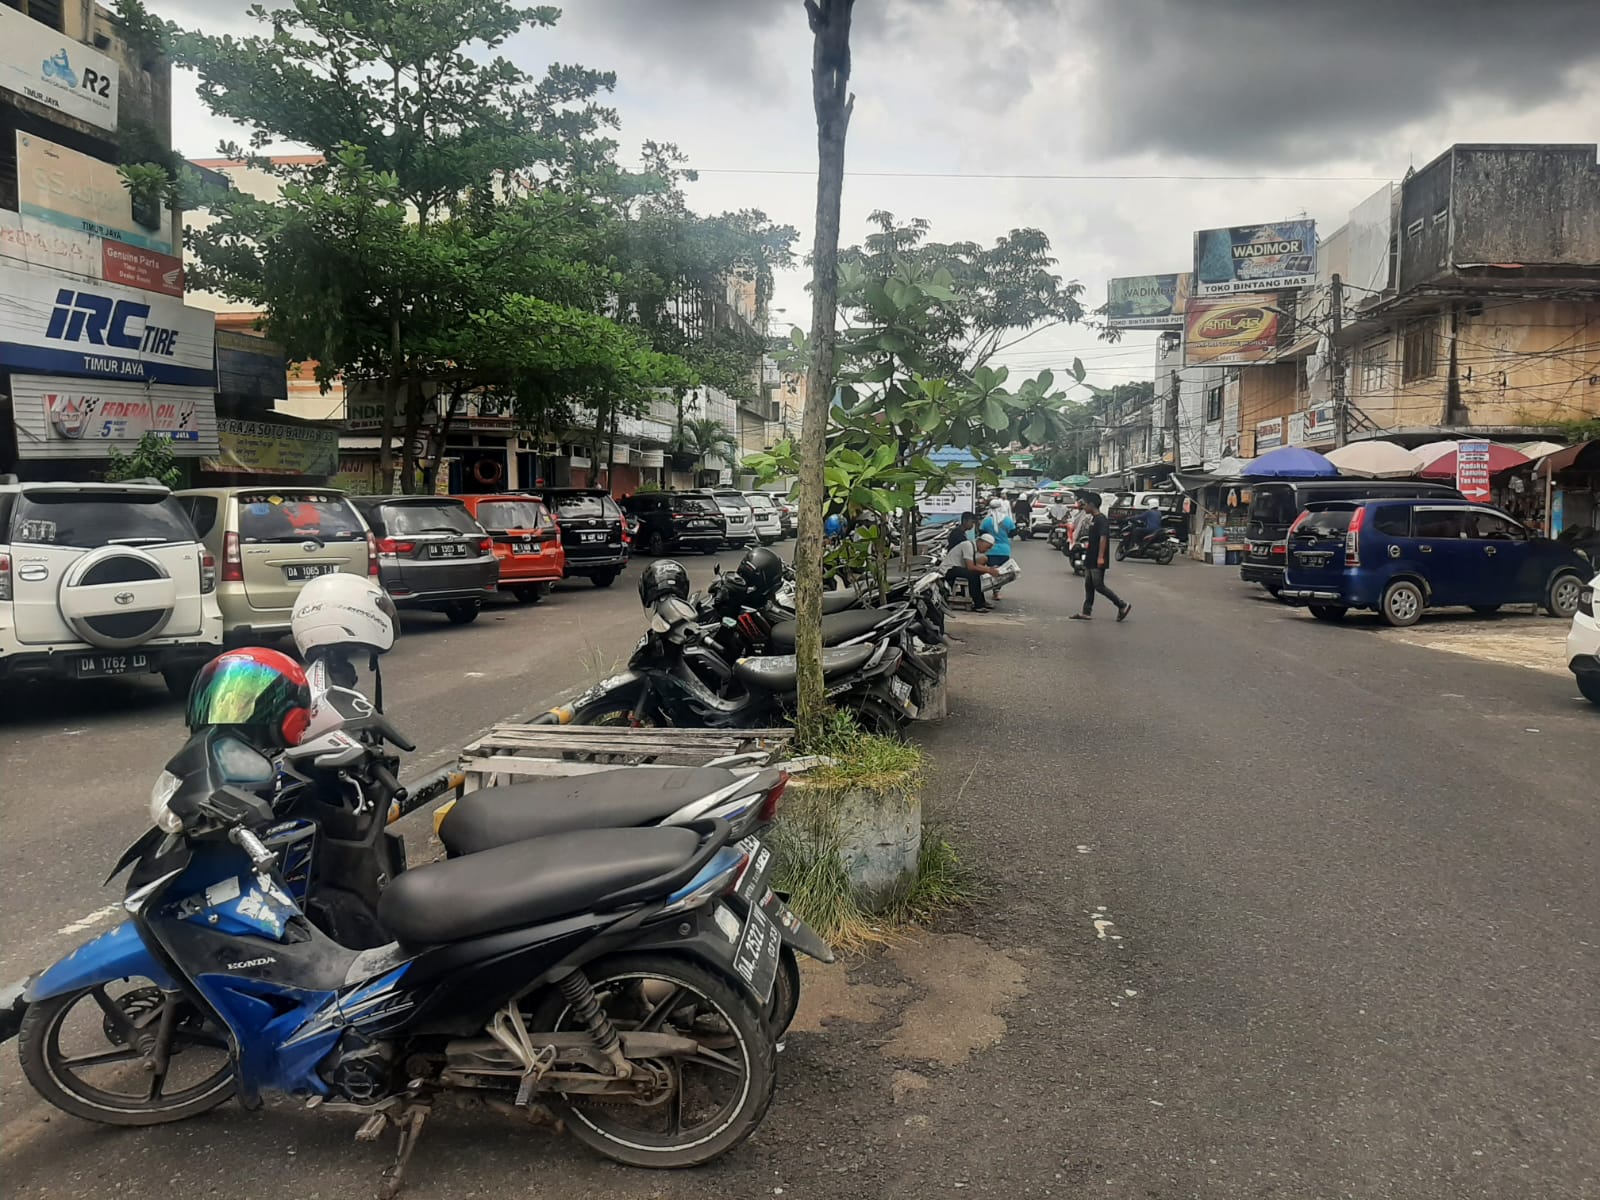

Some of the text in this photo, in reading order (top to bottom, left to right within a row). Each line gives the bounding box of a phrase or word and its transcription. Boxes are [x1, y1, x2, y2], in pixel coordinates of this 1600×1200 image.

[82, 67, 110, 98] R2
[24, 86, 60, 107] TIMUR JAYA
[82, 221, 122, 240] TIMUR JAYA
[1233, 241, 1300, 257] WADIMOR
[140, 255, 160, 269] Parts
[1124, 286, 1177, 297] WADIMOR
[1233, 279, 1281, 290] BINTANG
[1284, 277, 1307, 285] MAS
[141, 325, 179, 356] TIRE
[84, 356, 145, 376] TIMUR JAYA
[156, 404, 175, 417] OIL
[101, 420, 113, 437] 5
[229, 420, 256, 436] RAJA
[258, 423, 283, 439] SOTO
[288, 567, 298, 576] DA
[82, 659, 95, 671] DA
[102, 656, 126, 669] 1762
[133, 656, 146, 667] LD
[745, 923, 765, 960] 2522
[226, 957, 277, 971] HONDA
